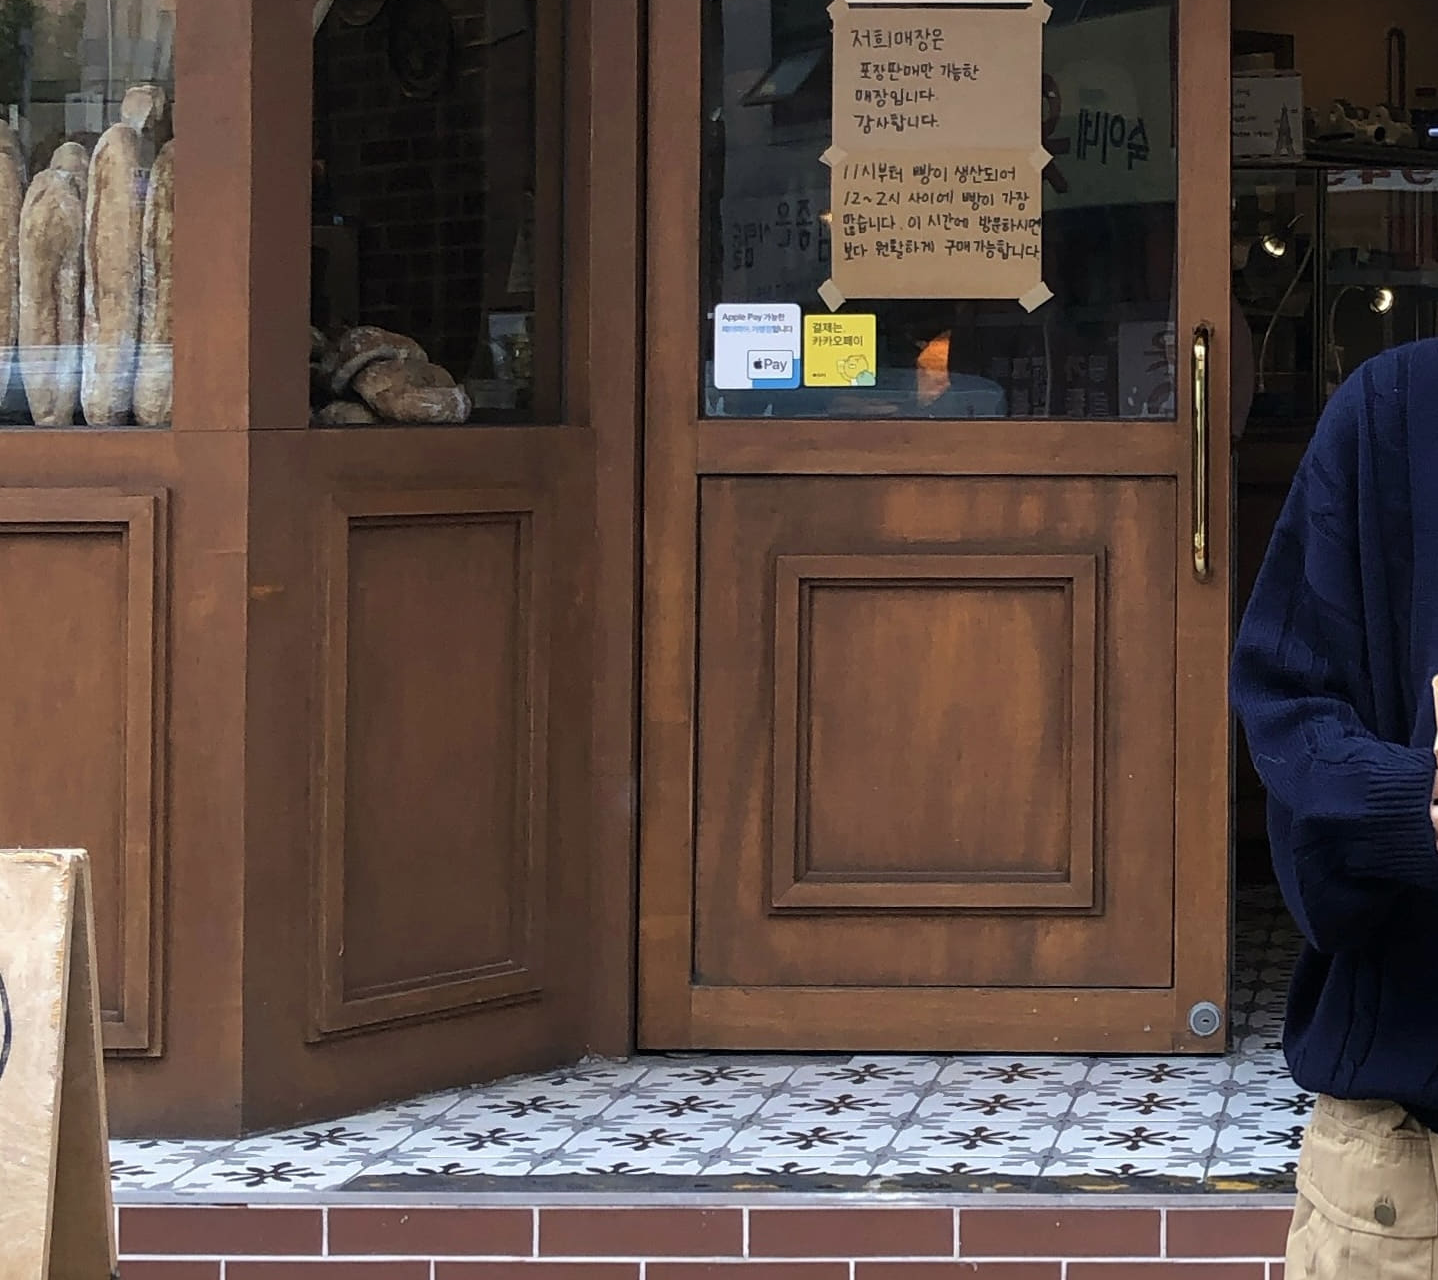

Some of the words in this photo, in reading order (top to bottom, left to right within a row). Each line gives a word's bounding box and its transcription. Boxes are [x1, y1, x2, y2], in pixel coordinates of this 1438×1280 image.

[939, 62, 980, 81] 가능한
[912, 163, 948, 185] 빵이
[954, 164, 1017, 184] 생산되어
[907, 190, 954, 206] 사이에
[961, 191, 995, 211] 빵이
[1001, 190, 1031, 211] 가장
[907, 214, 922, 231] 이
[927, 212, 969, 231] 시간에
[843, 241, 869, 261] 보다
[722, 312, 746, 322] Apple
[747, 312, 763, 322] Pay
[812, 335, 864, 347] 카카오페이
[764, 358, 788, 373] Pay
